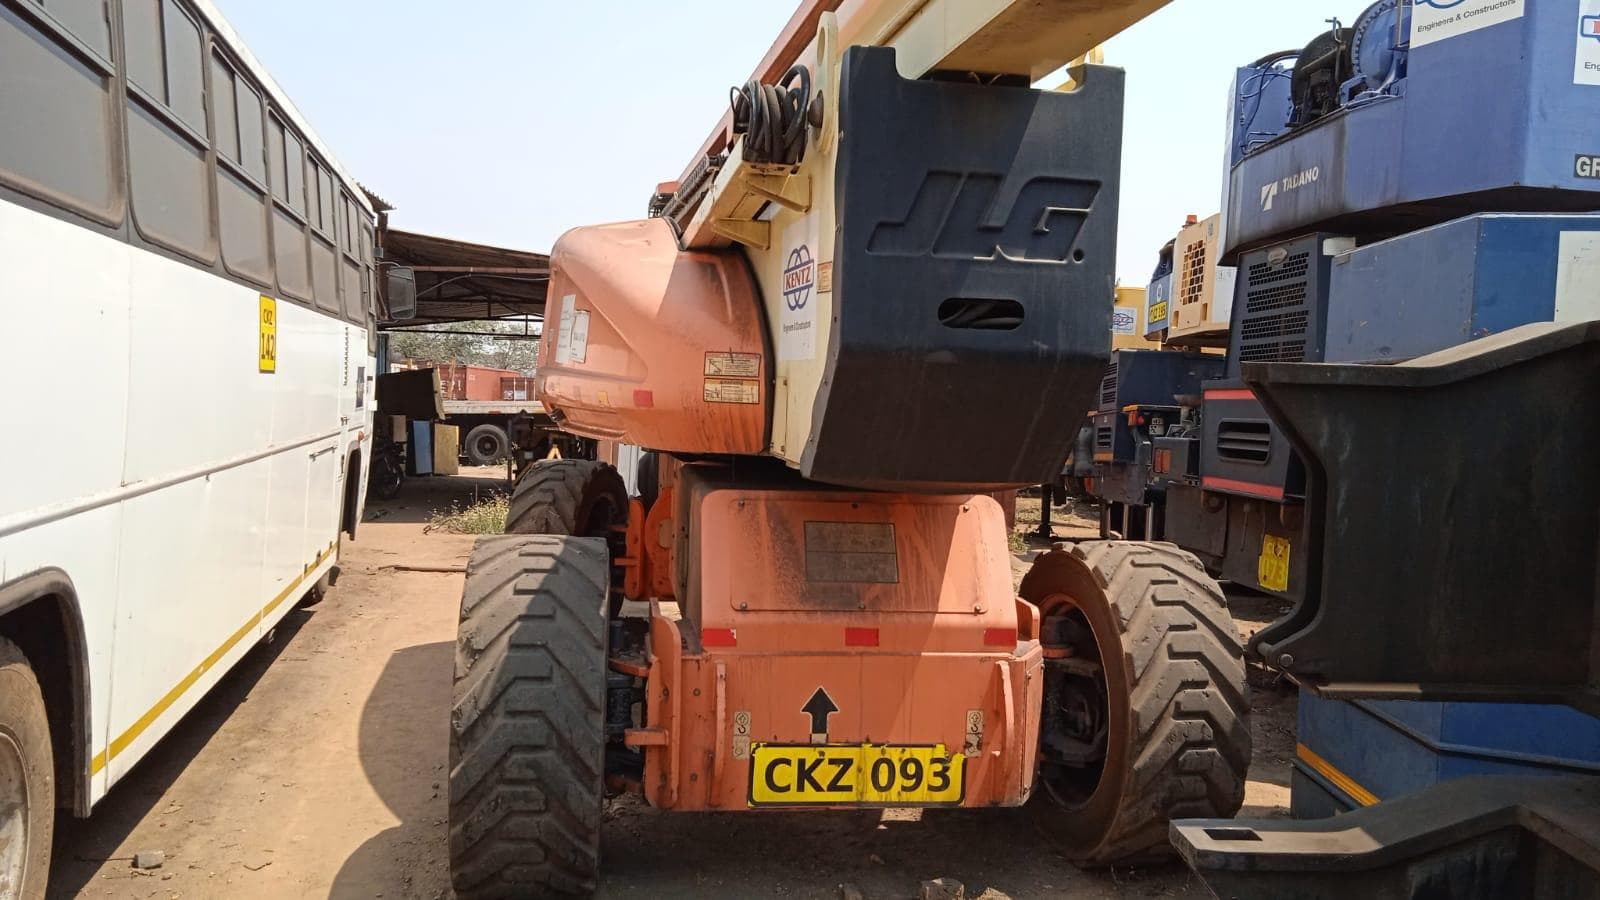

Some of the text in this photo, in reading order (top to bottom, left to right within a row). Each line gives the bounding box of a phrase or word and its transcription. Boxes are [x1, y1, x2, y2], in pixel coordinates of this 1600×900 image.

[1417, 0, 1516, 32] Engineers & Constructors
[1283, 166, 1319, 192] TADANO
[866, 170, 1102, 263] JLG
[785, 266, 812, 291] KENTZ
[261, 332, 275, 361] 142
[764, 757, 951, 793] CKZ 093
